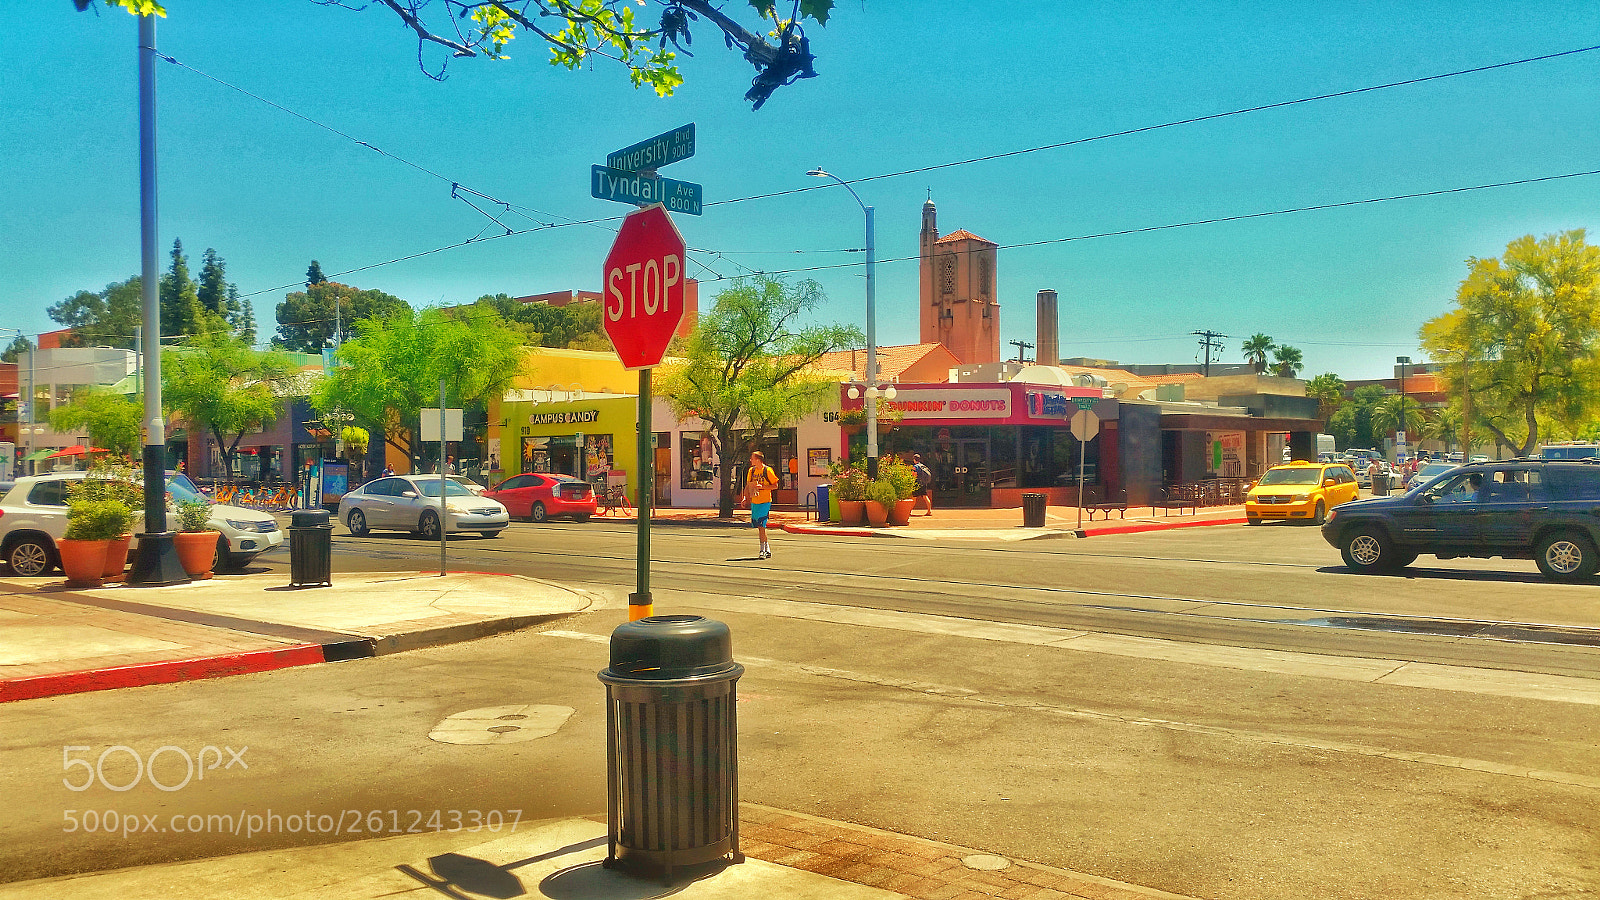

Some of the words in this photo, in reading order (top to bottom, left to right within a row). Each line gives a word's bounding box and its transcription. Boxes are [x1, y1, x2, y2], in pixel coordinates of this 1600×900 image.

[675, 128, 690, 144] Blvd
[609, 138, 669, 170] University
[672, 143, 686, 159] 900
[687, 141, 693, 154] E
[595, 169, 665, 202] Tyndall
[676, 183, 694, 197] Ave
[670, 196, 690, 211] 800
[693, 200, 700, 213] N
[607, 253, 681, 322] STOP
[887, 400, 947, 412] DUNKIN'
[949, 399, 1006, 412] DONUTS
[528, 412, 564, 424] CAMPUS
[564, 409, 600, 424] CANDY
